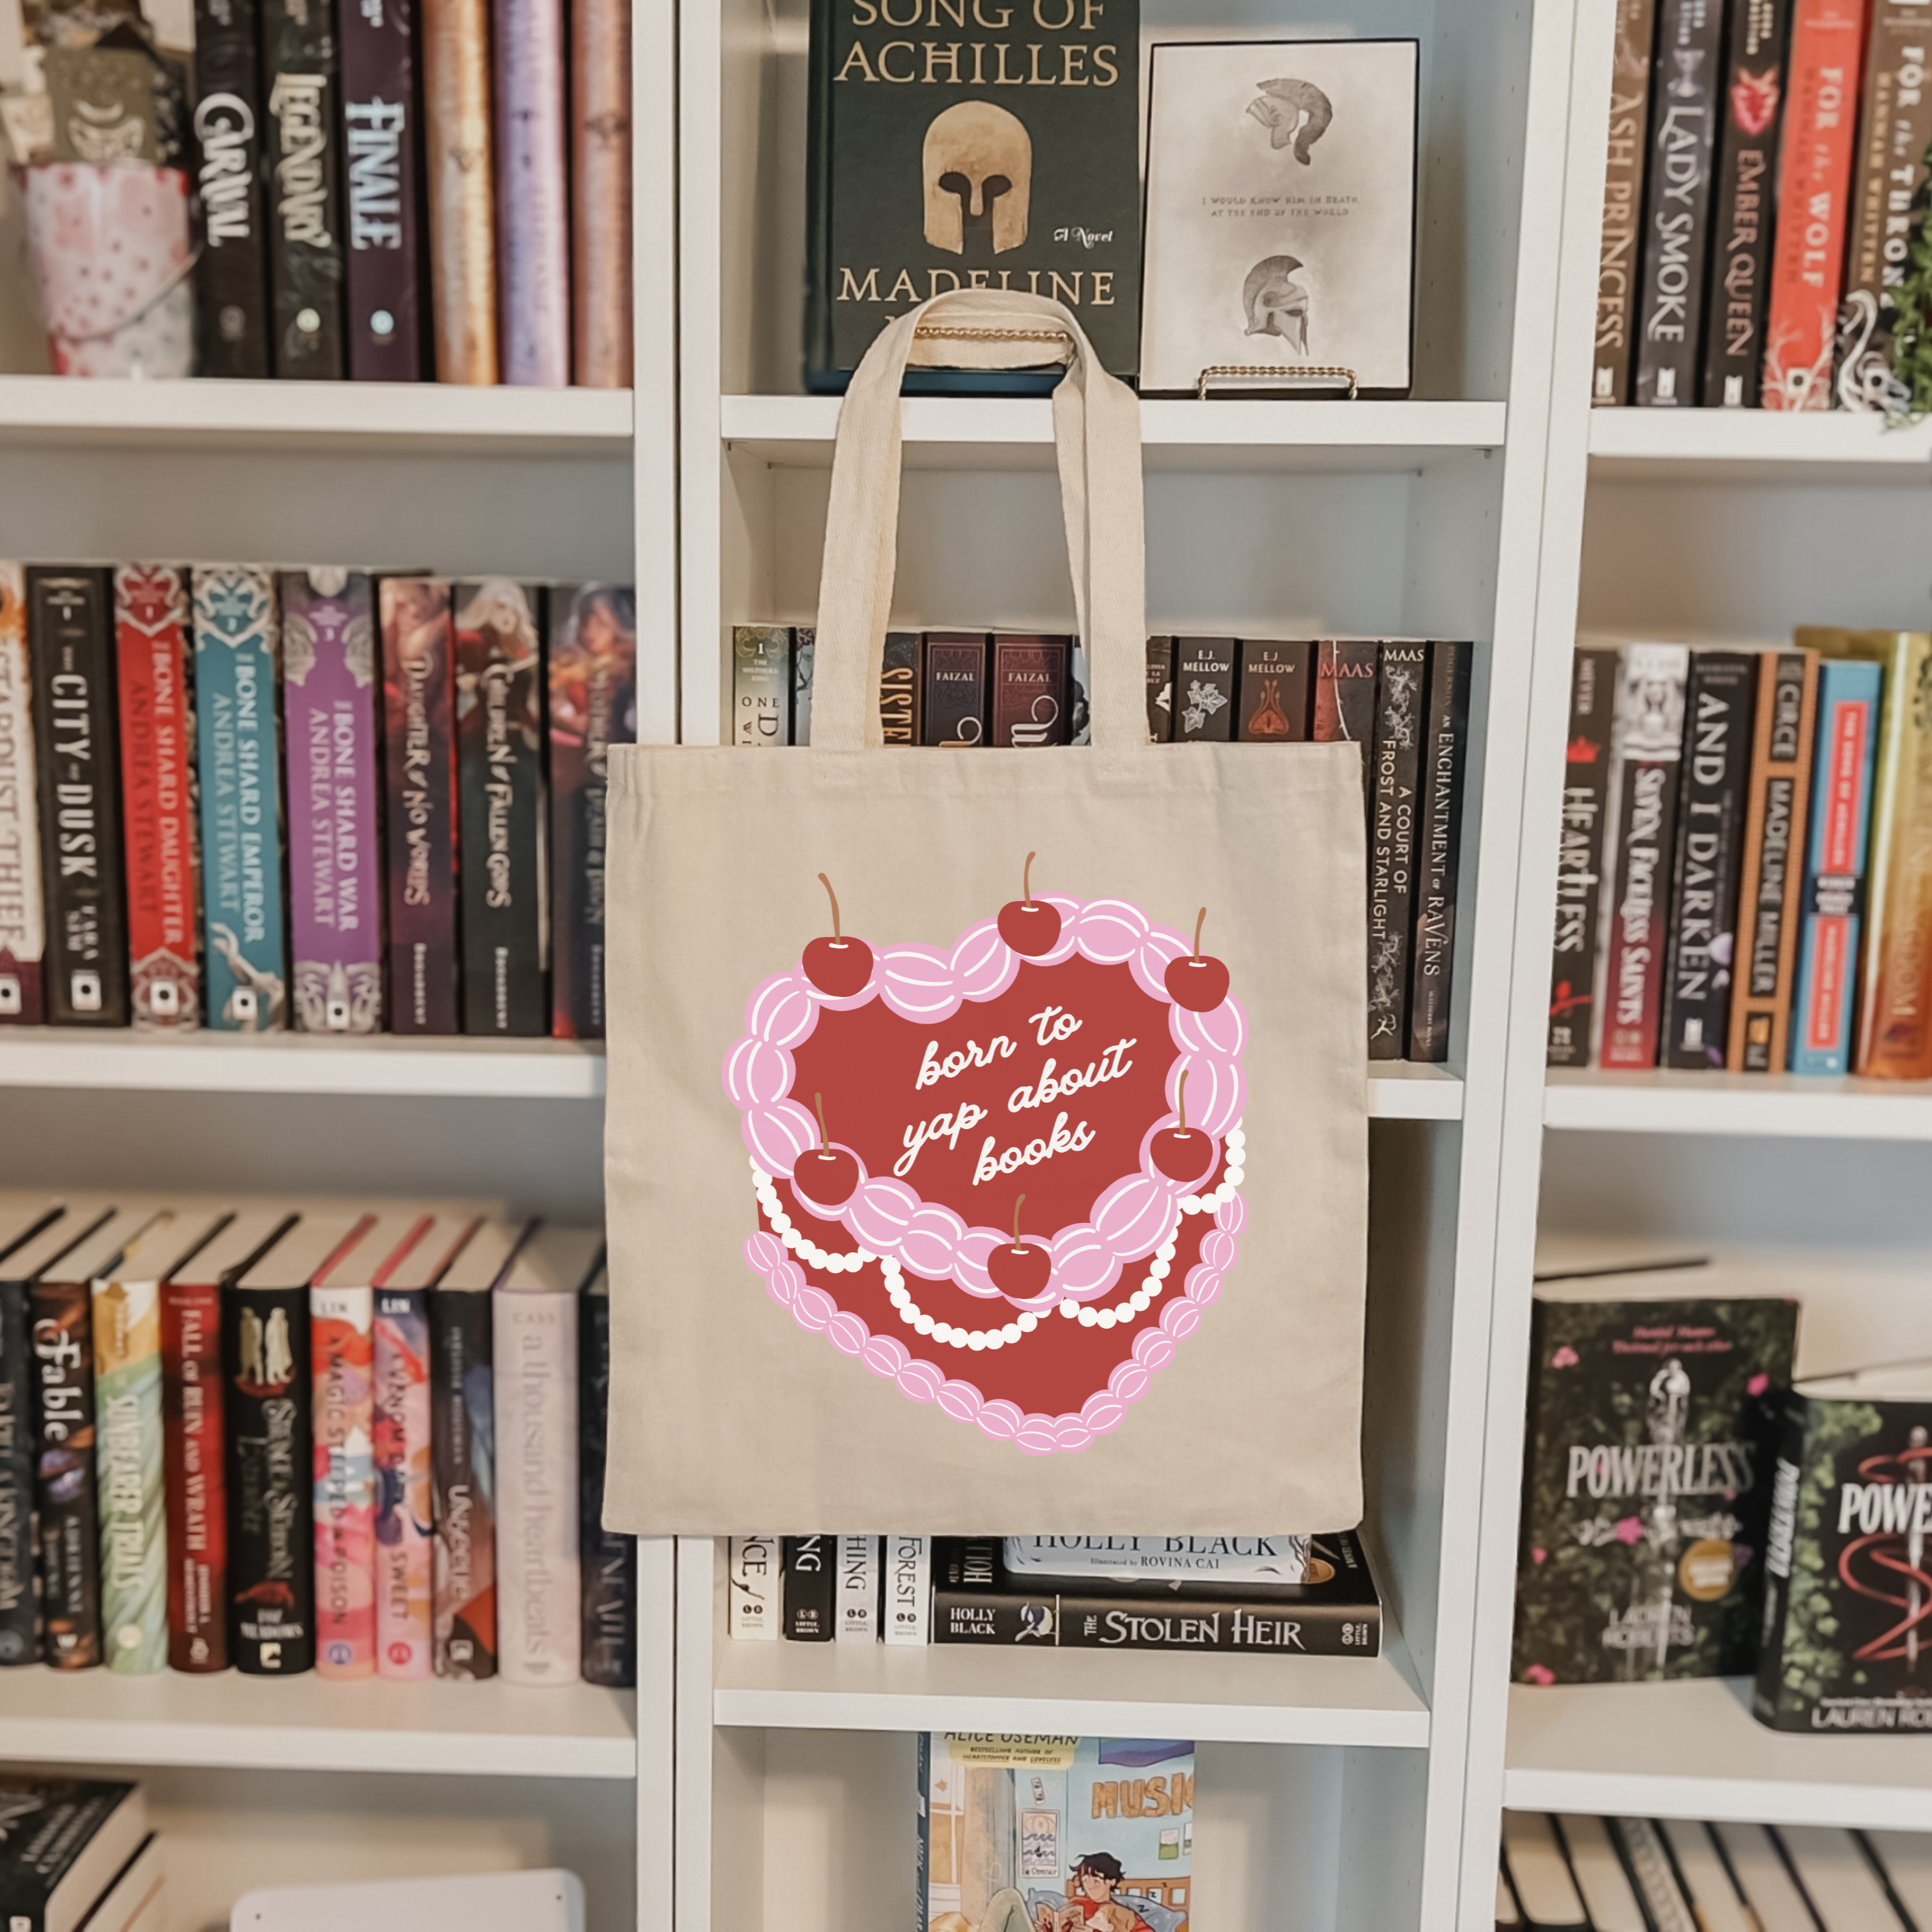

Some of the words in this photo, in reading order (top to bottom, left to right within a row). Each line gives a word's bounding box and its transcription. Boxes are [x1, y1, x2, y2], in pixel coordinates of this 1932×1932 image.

[852, 0, 1014, 28] SONG
[1033, 0, 1103, 29] OF
[833, 40, 1119, 87] ACHILLES
[1896, 45, 1926, 110] FOR
[1607, 92, 1645, 166] ASH
[1814, 67, 1844, 131] FOR
[345, 95, 405, 250] FINALE
[1657, 105, 1705, 206] LADY
[1726, 149, 1767, 252] EMBER
[1071, 226, 1113, 249] Novel
[1595, 181, 1634, 348] PRINCESS
[1801, 190, 1832, 289] WOLF
[1647, 211, 1694, 343] SMOKE
[1725, 252, 1756, 357] QUEEN
[153, 652, 176, 715] BONE
[936, 672, 975, 682] FAIZAL
[1008, 672, 1051, 682] FAIZAL
[1183, 662, 1229, 672] MELLOW
[1198, 650, 1216, 660] E.J.
[1248, 664, 1295, 673] MELLOW
[1321, 663, 1373, 678] MAAS
[1384, 649, 1424, 662] MAAS
[52, 674, 92, 760] CITY
[235, 665, 258, 732] BONE
[741, 697, 780, 708] ONE
[880, 667, 914, 746] SISTE
[1442, 715, 1451, 728] AN
[1771, 683, 1801, 759] CIRCE
[156, 724, 179, 811] SHARD
[212, 692, 236, 797] ANDREA
[309, 706, 332, 811] ANDREA
[333, 712, 356, 779] BONE
[1379, 740, 1396, 796] FROST
[1692, 692, 1730, 786] AND
[237, 738, 262, 826] SHARD
[402, 789, 434, 825] NO
[1397, 786, 1412, 799] A
[1430, 733, 1454, 876] ENCHANTMENT
[1690, 801, 1721, 816] I
[57, 784, 97, 877] DUSK
[334, 784, 359, 872] SHARD
[1376, 801, 1392, 840] AND
[1395, 804, 1411, 865] COURT
[1759, 780, 1792, 901] MADELINE
[158, 816, 184, 945] DAUGHTER
[216, 802, 240, 914] STEWART
[240, 832, 265, 943] EMPEROR
[313, 817, 336, 928] STEWART
[1393, 870, 1408, 894] OF
[1554, 787, 1599, 953] HEARTLESS
[338, 876, 359, 932] WAR
[1373, 846, 1391, 940] STARLIGHT
[1677, 833, 1720, 1000] DARKEN
[1424, 896, 1449, 976] RAVENS
[915, 1034, 1018, 1090] born
[1028, 1005, 1083, 1046] to
[893, 1102, 988, 1177] yap
[1007, 1038, 1138, 1113] about
[972, 1111, 1097, 1186] books
[181, 1310, 202, 1358] FALL
[34, 1318, 83, 1442] Fable
[326, 1353, 344, 1420] MAGIC
[522, 1361, 552, 1496] thousand
[1566, 1441, 1756, 1499] POWERLESS
[185, 1473, 206, 1551] WRATH
[1837, 1482, 1932, 1535] POWE
[843, 1535, 867, 1591] HING
[894, 1536, 922, 1607] FOREST
[1140, 1556, 1191, 1568] ROVINA
[1192, 1557, 1220, 1569] CAI
[1163, 1536, 1278, 1556] BLACK
[390, 1551, 409, 1620] SWEET
[950, 1607, 996, 1622] HOLLY
[950, 1622, 996, 1634] BLACK
[1083, 1614, 1098, 1636] THE
[1098, 1610, 1221, 1644] STOLEN
[1231, 1608, 1306, 1651] HEIR
[943, 1732, 994, 1743] ALICE
[1001, 1733, 1079, 1746] OSEMAN
